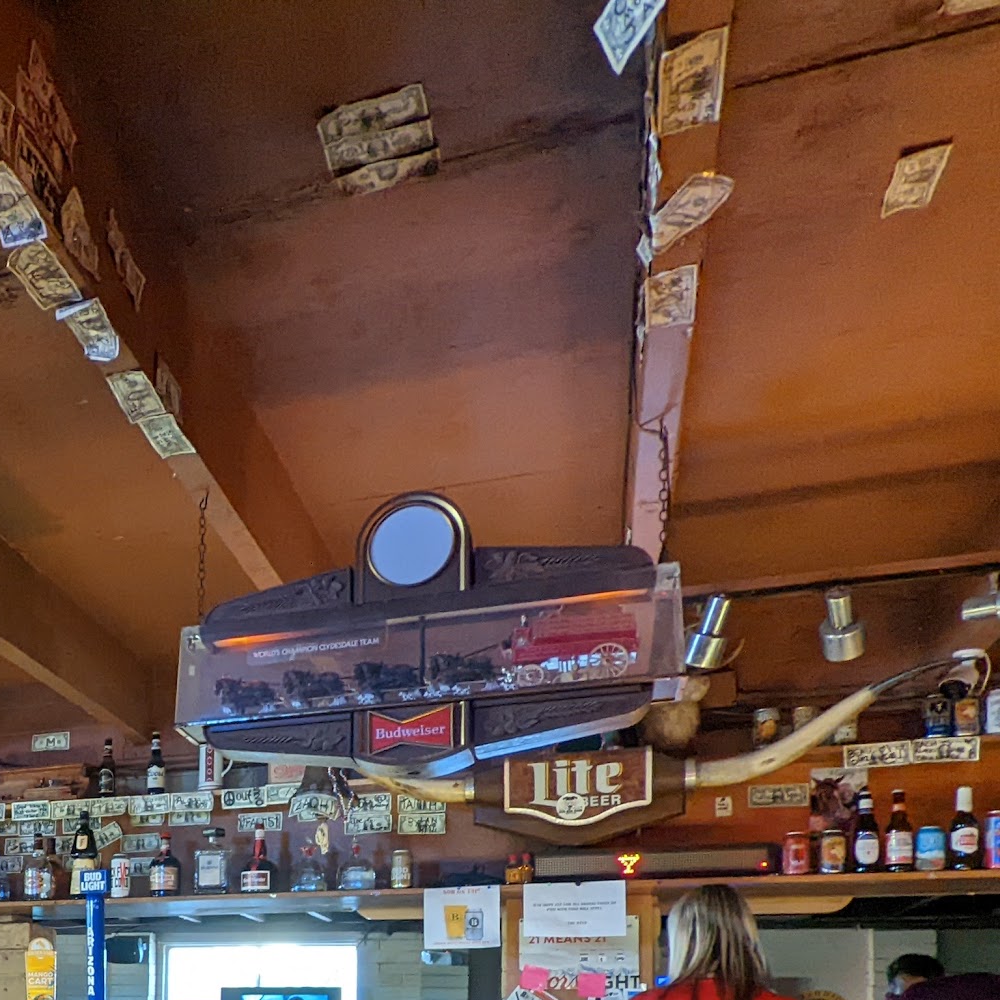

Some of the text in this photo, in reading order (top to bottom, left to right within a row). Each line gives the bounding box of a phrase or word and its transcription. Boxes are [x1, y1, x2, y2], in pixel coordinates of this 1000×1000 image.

[318, 640, 359, 651] CLYDESDALE
[360, 637, 380, 646] TEAM
[375, 725, 446, 740] Budweiser
[527, 759, 624, 807] Lite
[583, 794, 622, 808] BEER
[83, 872, 102, 881] BUD
[81, 881, 105, 891] LIGHT
[87, 927, 95, 996] ARIZONA
[28, 977, 54, 985] CART
